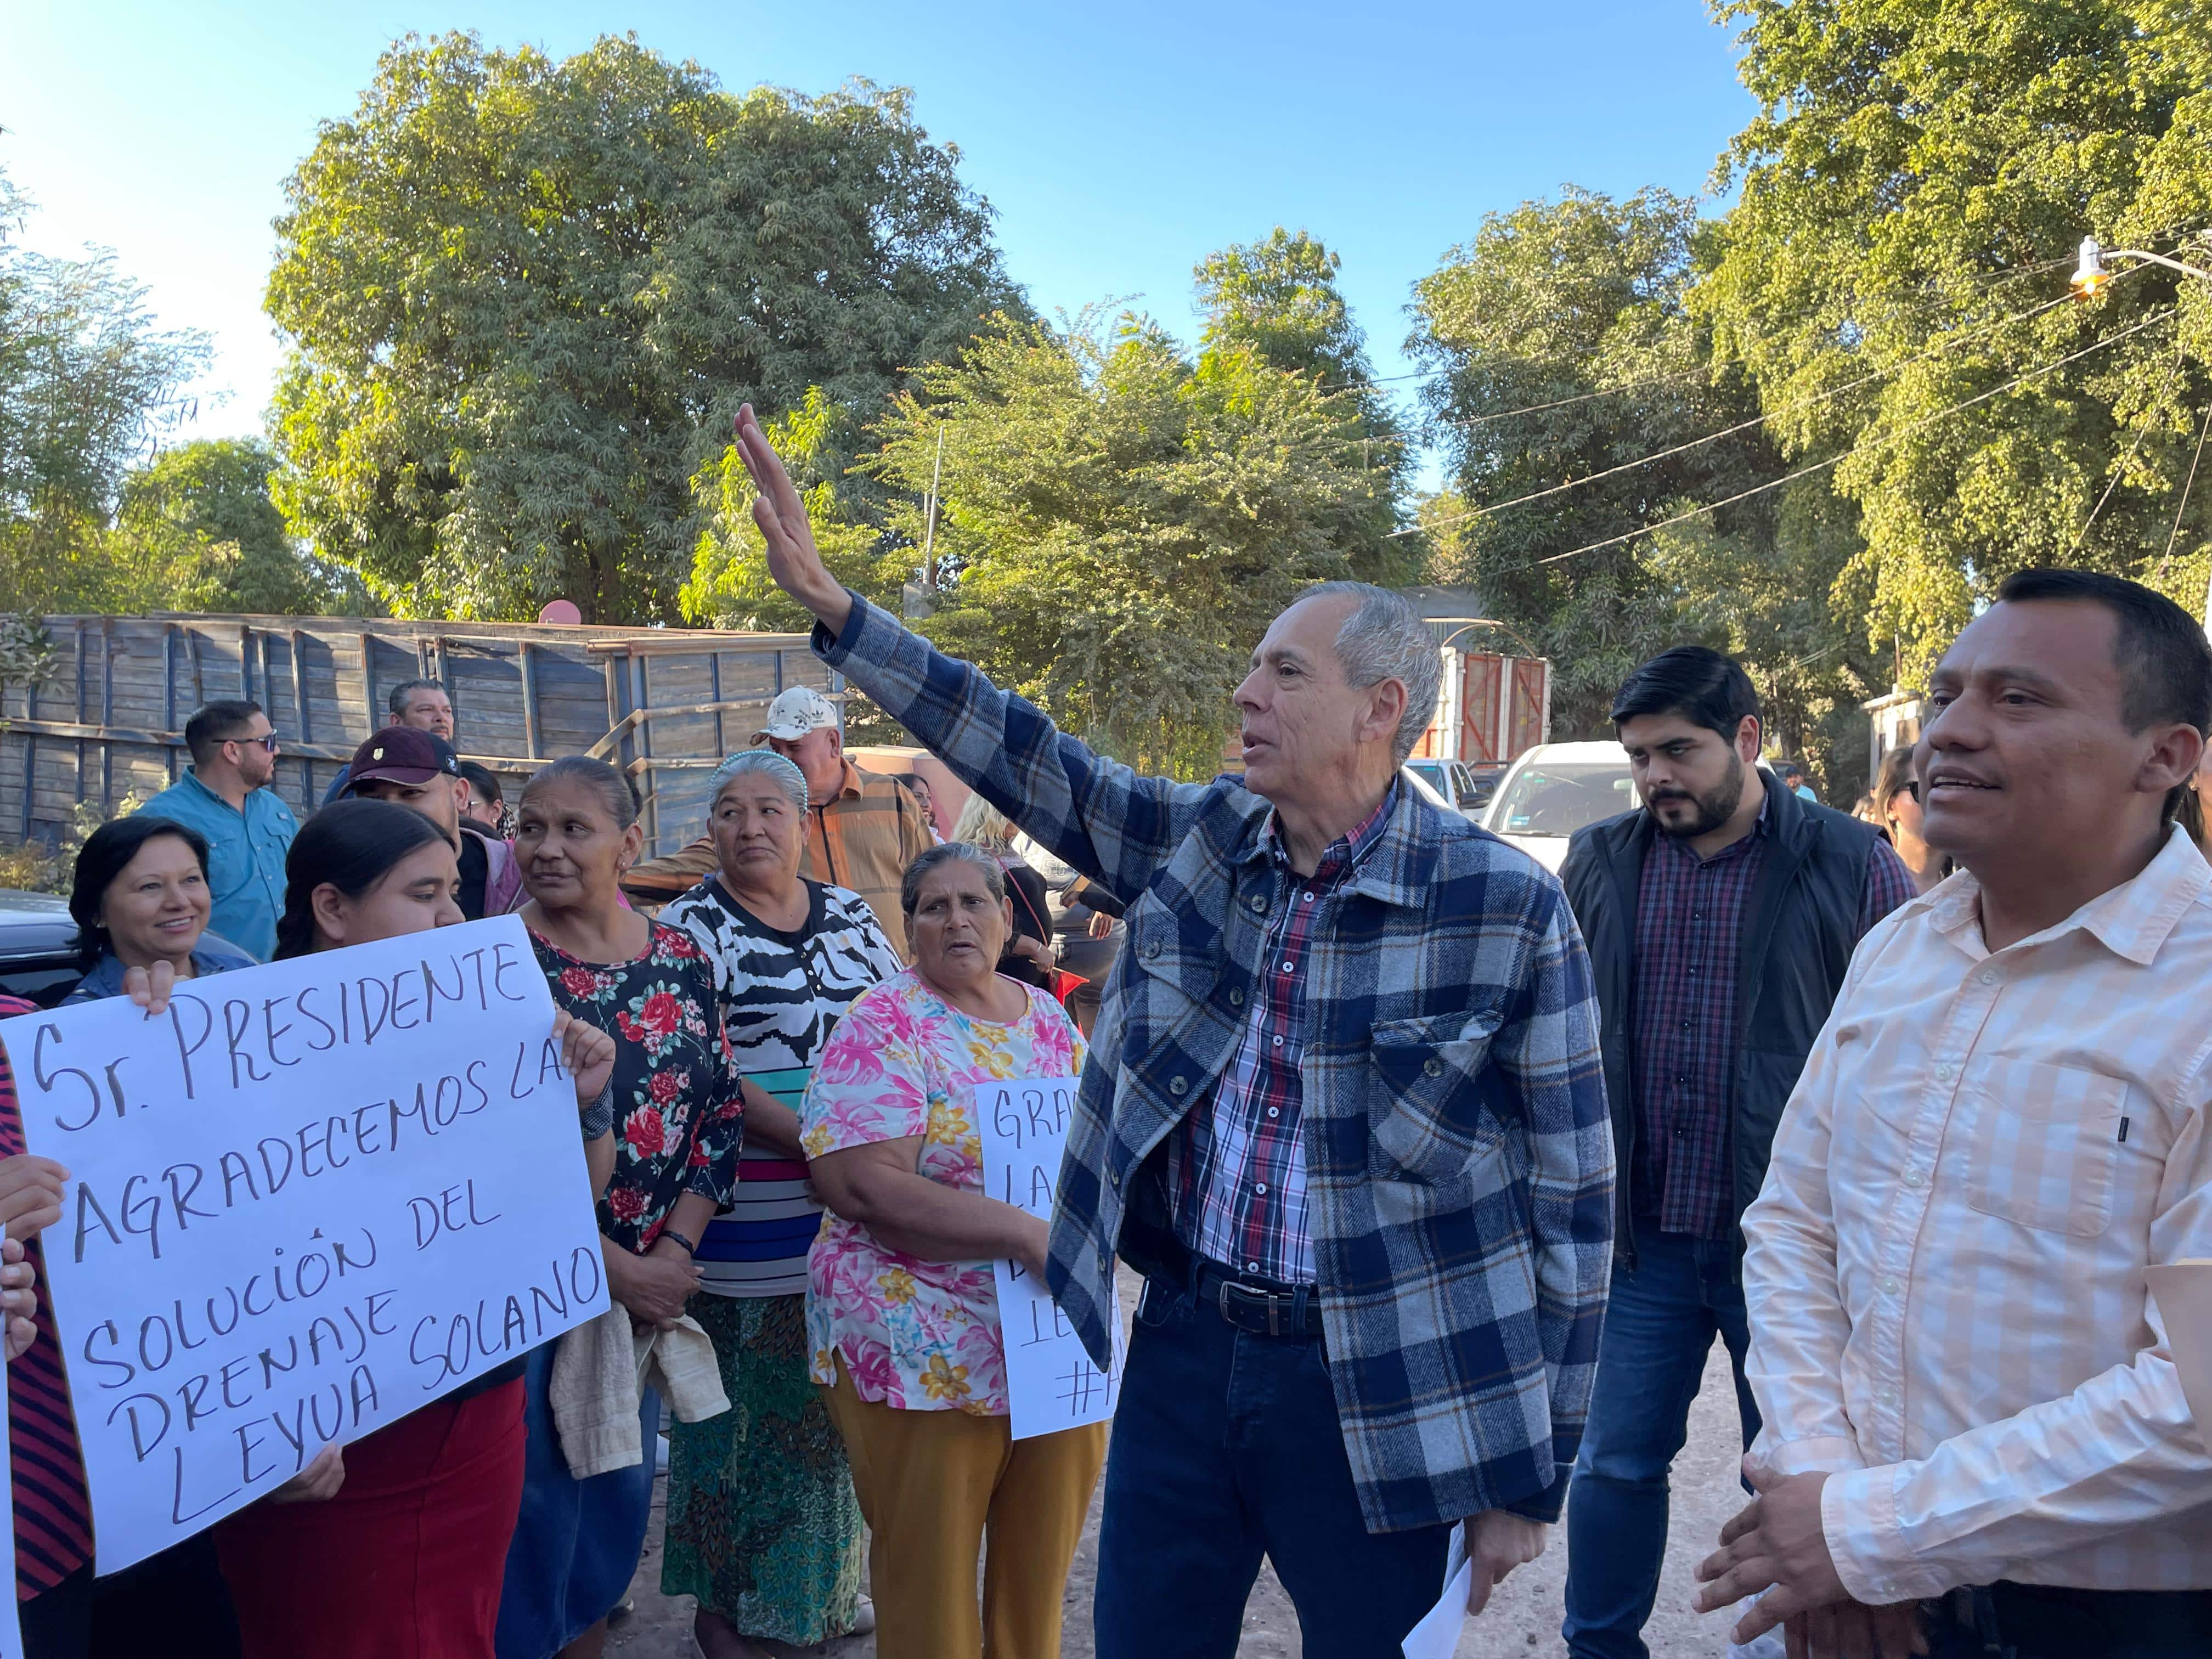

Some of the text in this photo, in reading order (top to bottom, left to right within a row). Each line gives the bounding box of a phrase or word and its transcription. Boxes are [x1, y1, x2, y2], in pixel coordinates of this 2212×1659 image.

[33, 943, 526, 1132] Sr. PRESIDENTE
[994, 1088, 1077, 1149] GRA
[74, 1037, 563, 1264] AGRADECEMOS LA
[83, 1178, 502, 1390] SOLUCIÓN DEL
[409, 1246, 600, 1391] SOLANO
[106, 1288, 399, 1464] DRENAJE
